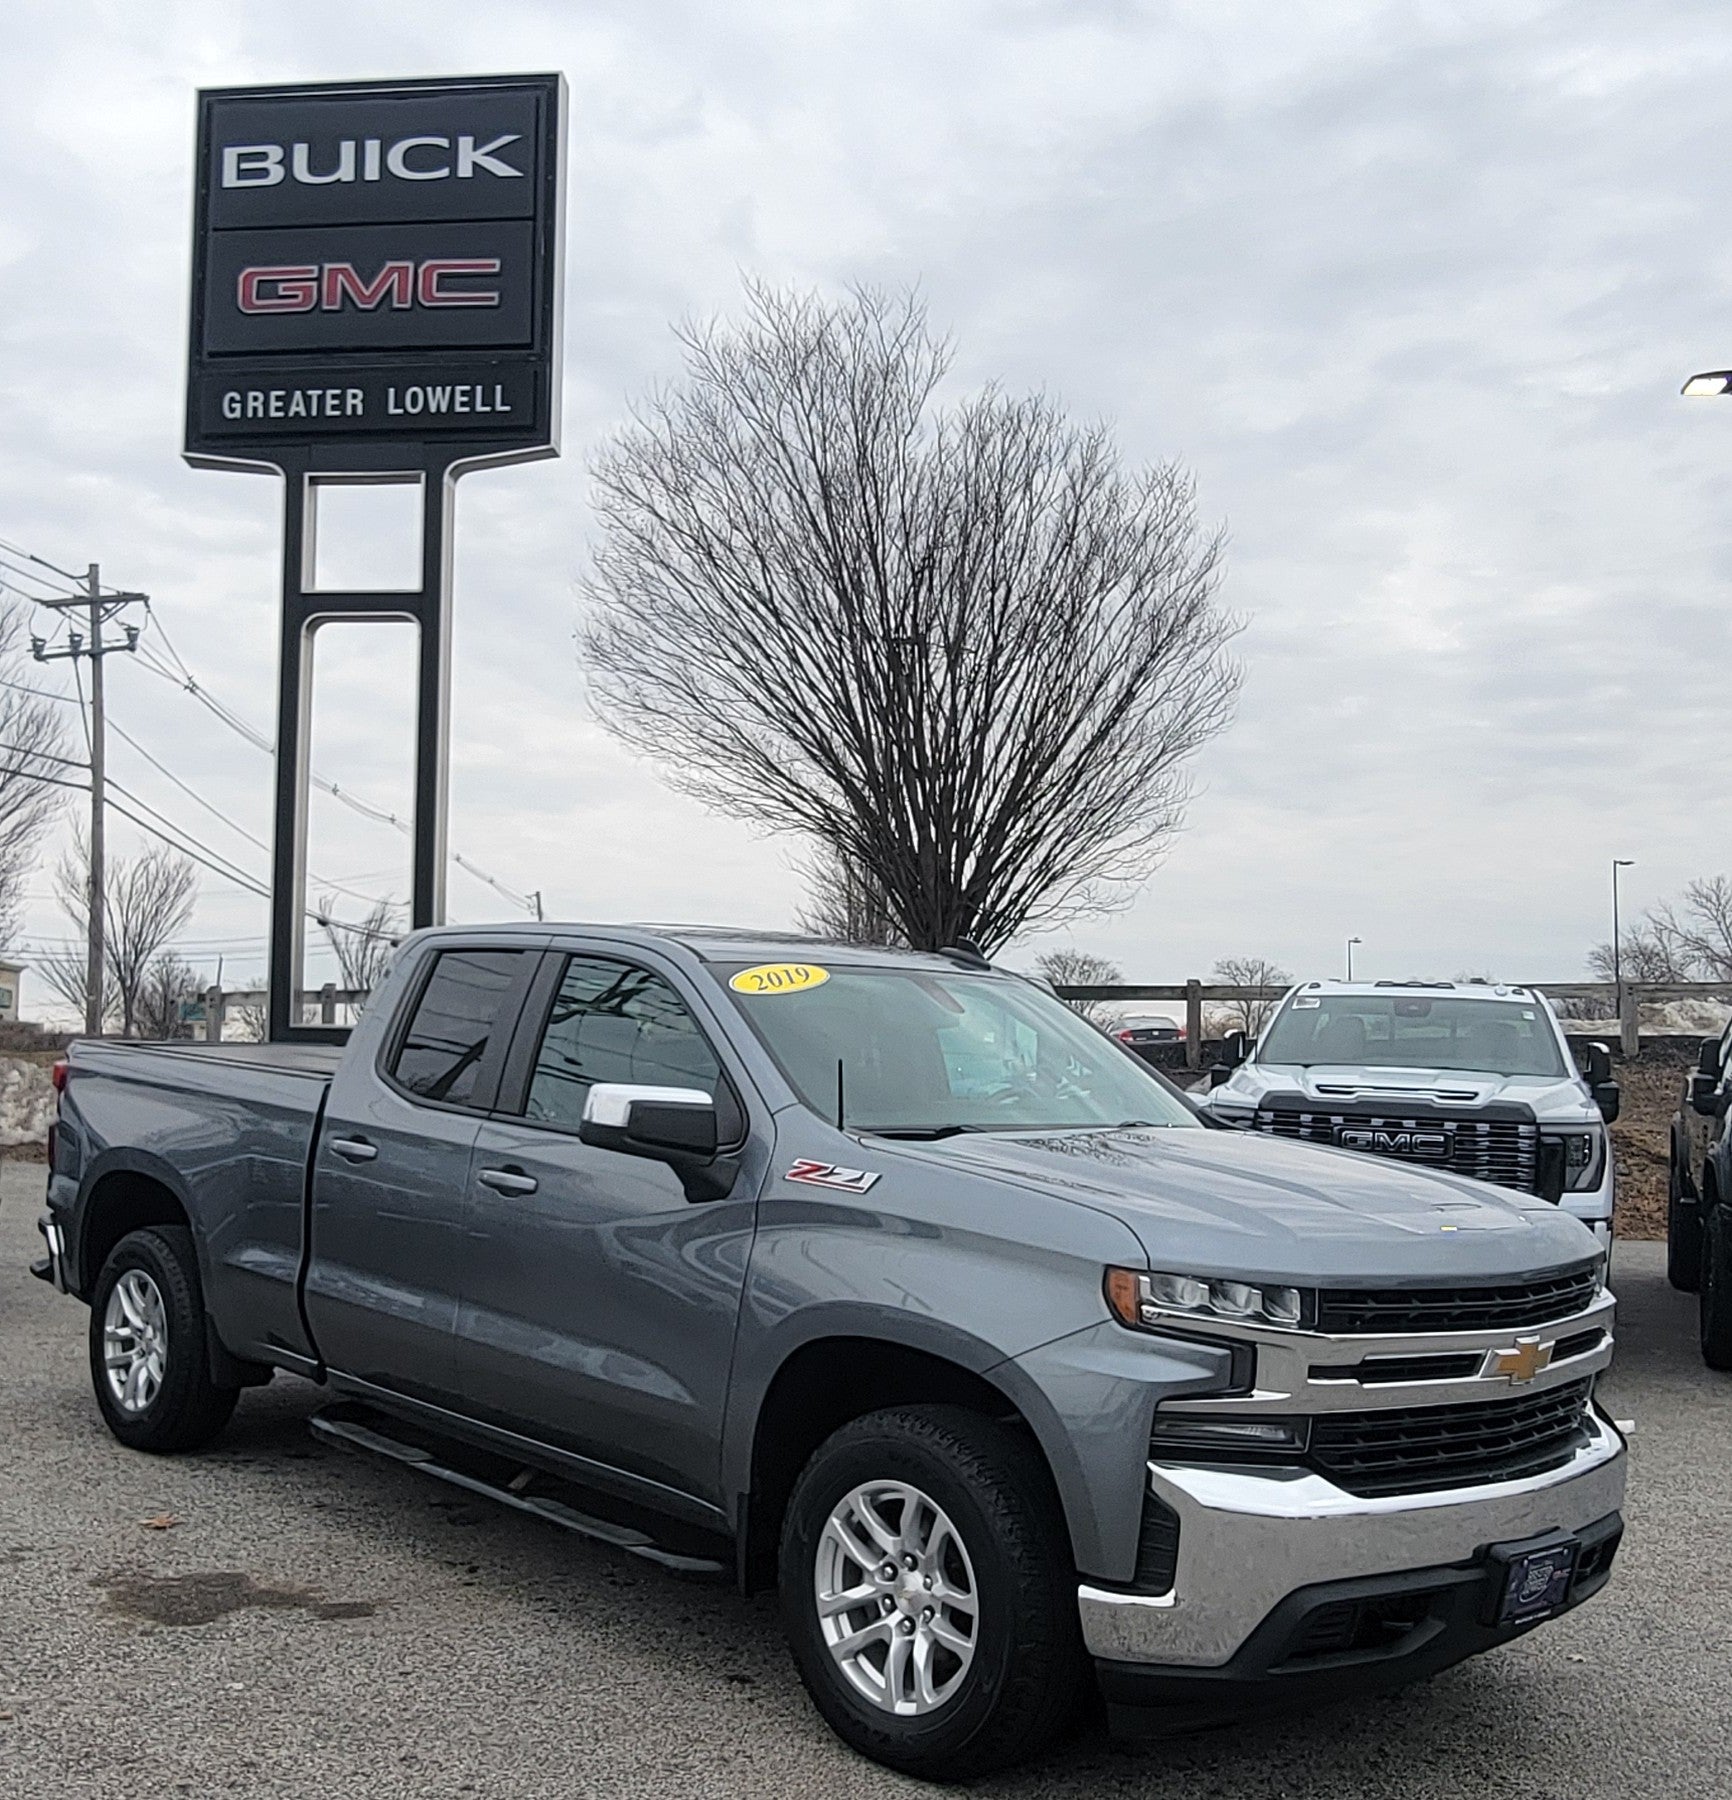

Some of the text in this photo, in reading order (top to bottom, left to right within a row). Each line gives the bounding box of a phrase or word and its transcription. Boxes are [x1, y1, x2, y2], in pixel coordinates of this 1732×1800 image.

[221, 134, 524, 189] BUICK
[237, 258, 500, 314] GMC
[222, 384, 512, 419] GREATER LOWELL
[750, 966, 810, 991] 2019
[1341, 1130, 1445, 1154] GMC
[784, 1157, 882, 1194] Z71
